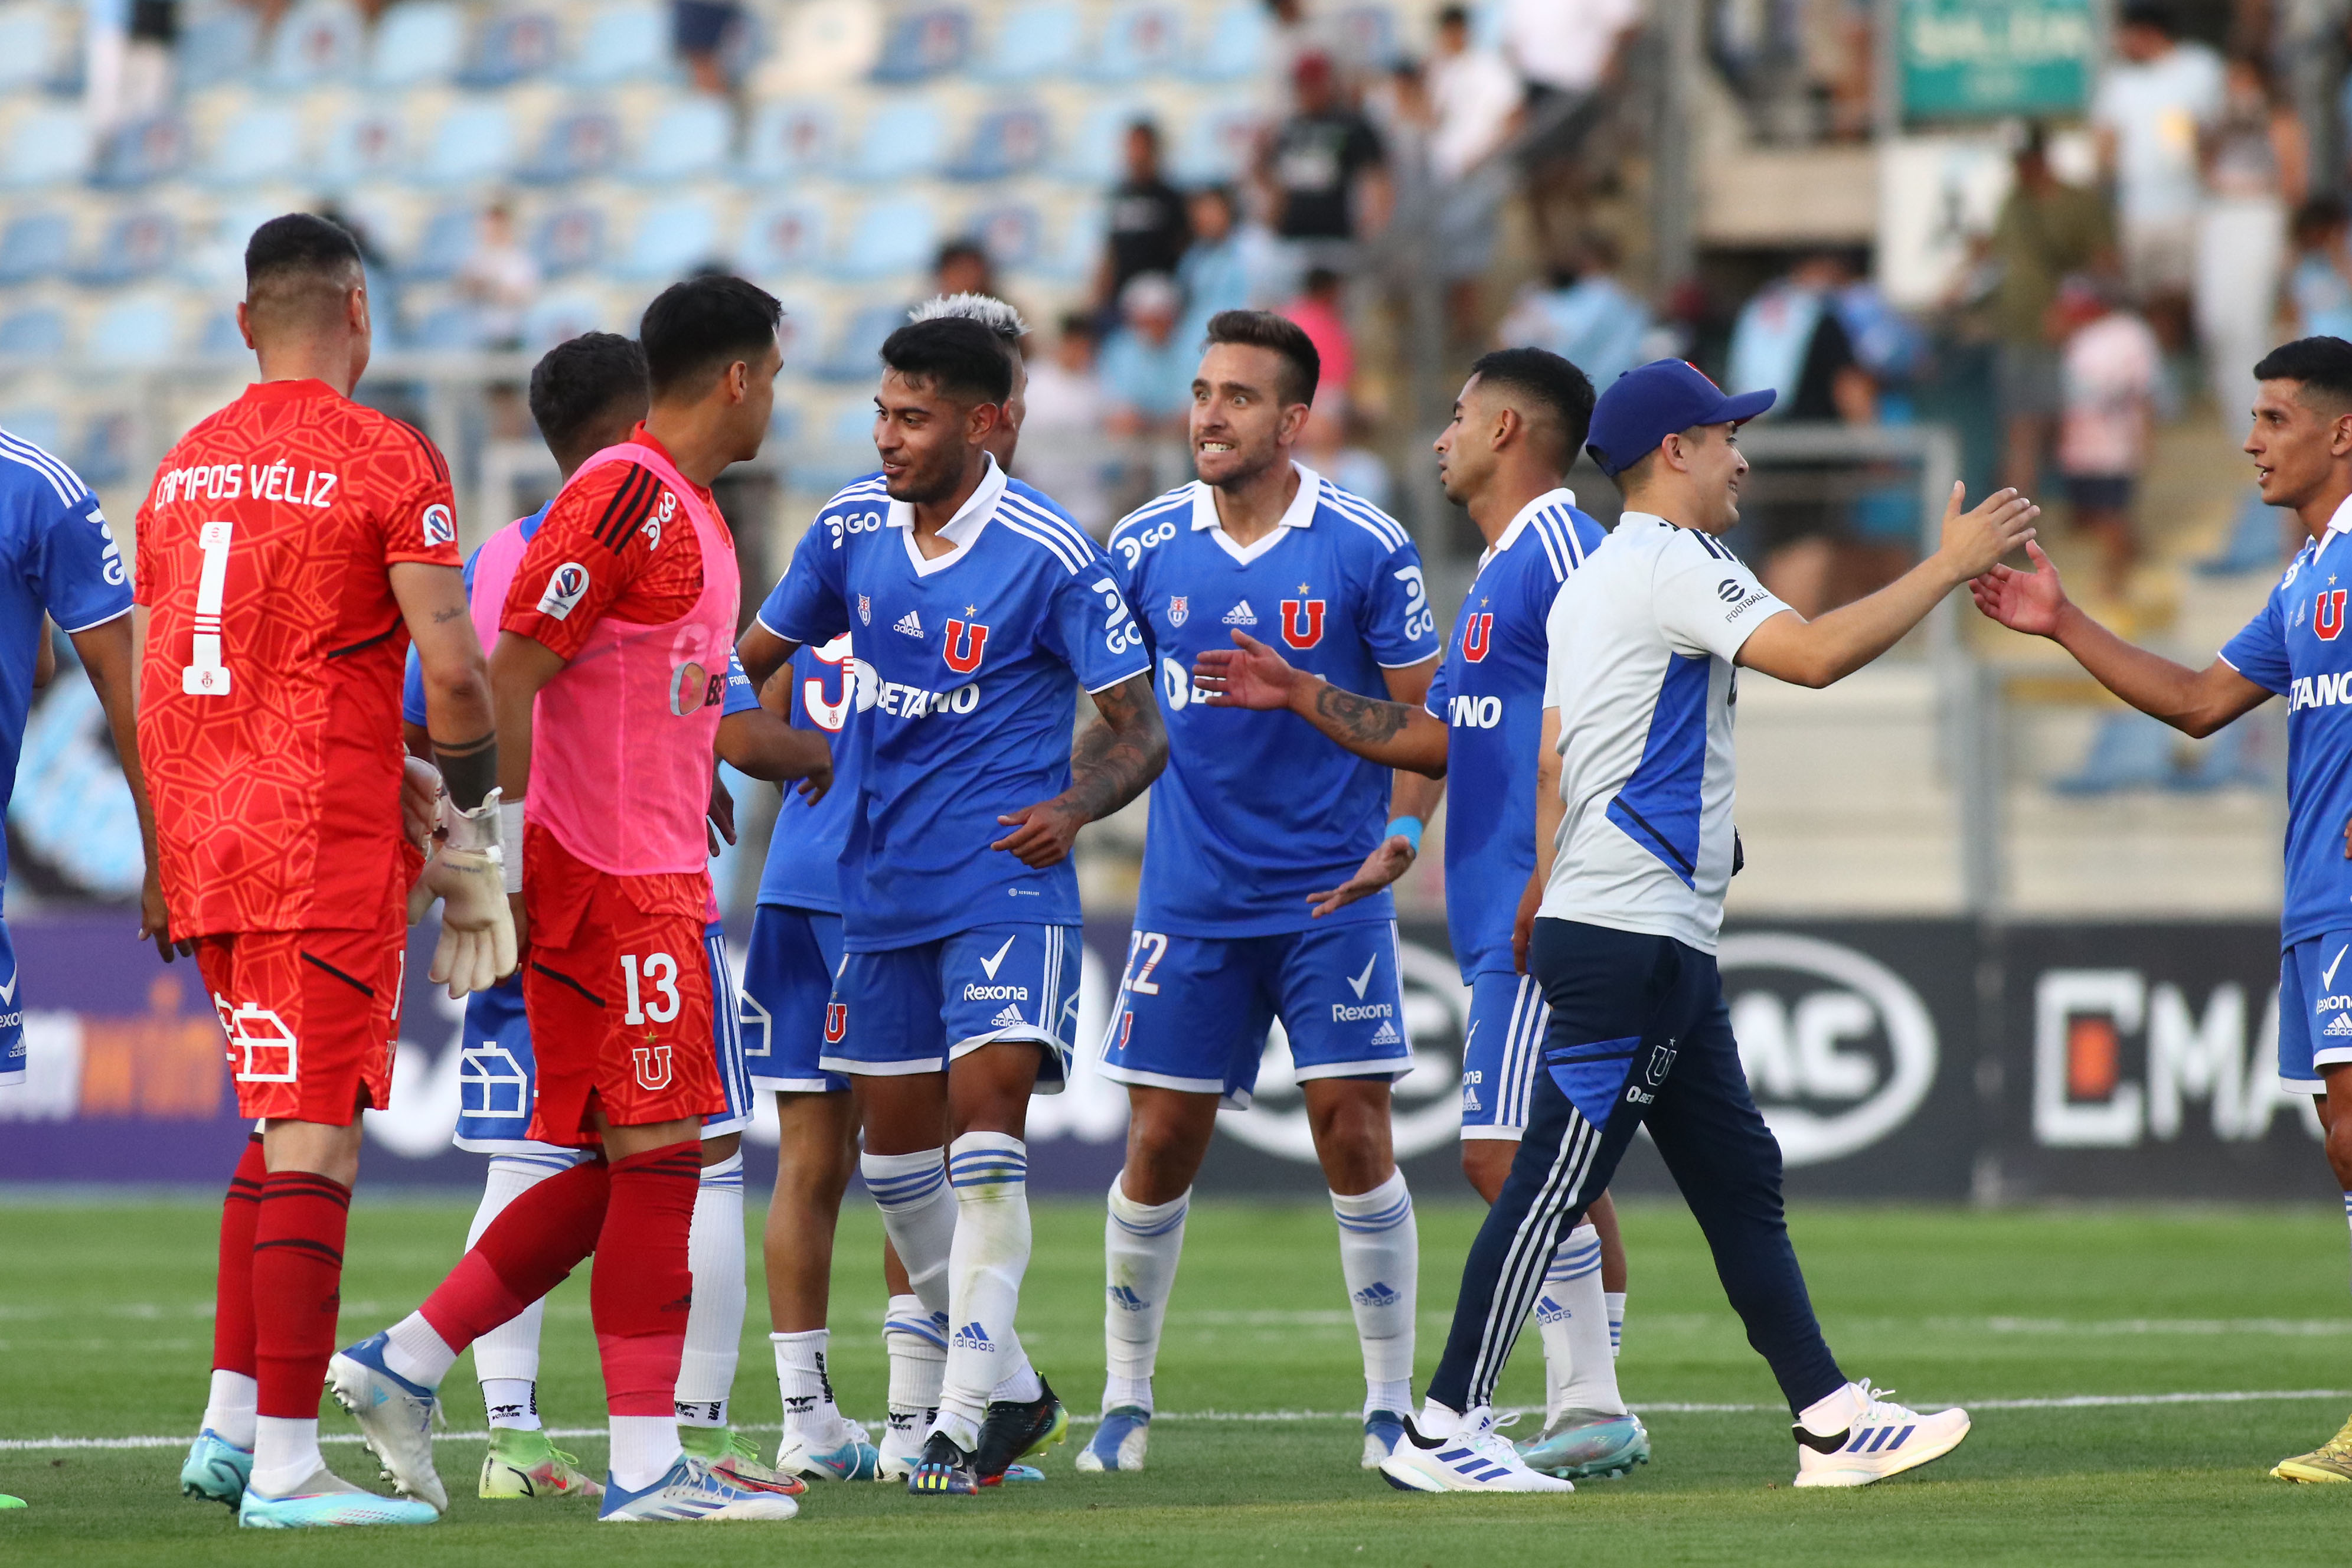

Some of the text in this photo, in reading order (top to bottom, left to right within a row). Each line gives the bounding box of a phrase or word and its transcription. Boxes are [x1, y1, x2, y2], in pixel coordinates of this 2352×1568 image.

[155, 458, 337, 511] CAMPOS VÉLIZ
[182, 521, 234, 695] 1
[1221, 616, 1258, 625] adidas
[1279, 599, 1326, 649] U
[1725, 592, 1769, 623] FOOTBALL
[893, 623, 925, 639] adidas
[942, 618, 989, 674] U
[1462, 612, 1494, 663] U
[877, 677, 981, 719] BETANO
[1125, 929, 1169, 995] 22
[620, 952, 680, 1025] 13
[963, 982, 1028, 1001] Rexona
[1332, 1003, 1393, 1023] Rexona
[2323, 1027, 2352, 1036] adida
[632, 1045, 672, 1091] U
